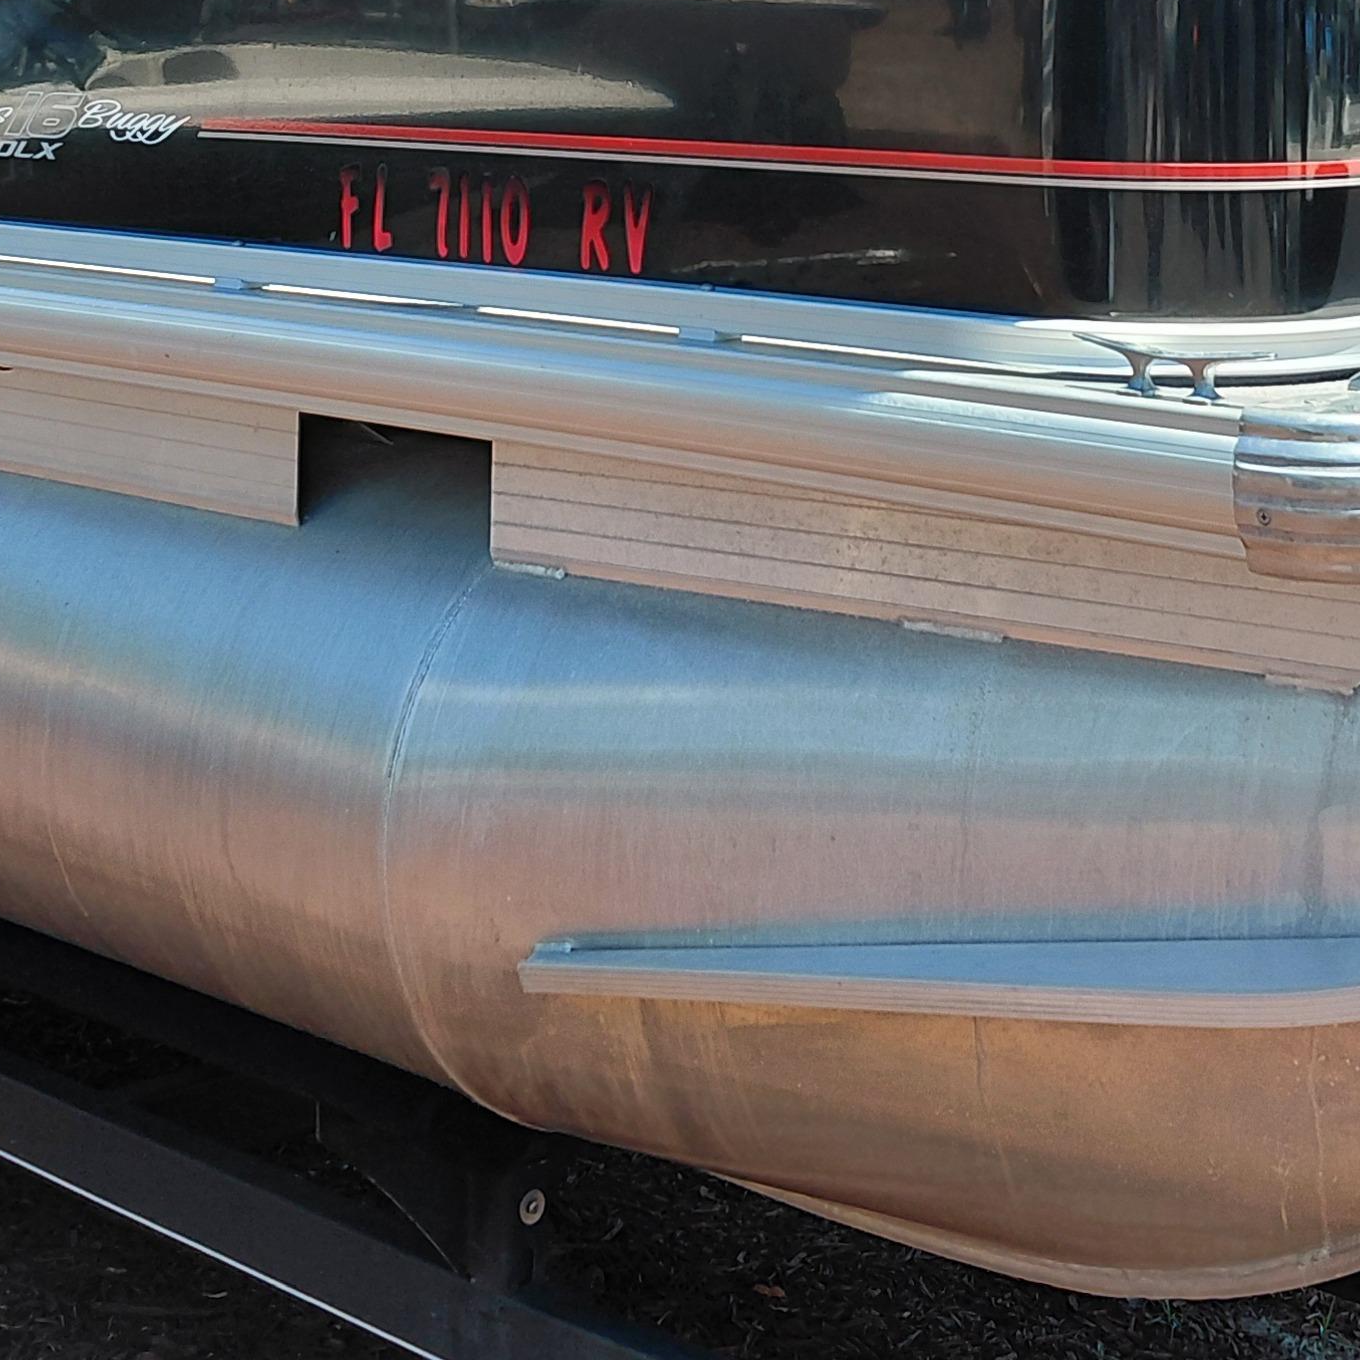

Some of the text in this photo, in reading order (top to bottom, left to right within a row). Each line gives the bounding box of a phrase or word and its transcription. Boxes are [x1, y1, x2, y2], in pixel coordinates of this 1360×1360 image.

[4, 91, 88, 139] 16
[77, 99, 191, 144] Buggy
[340, 162, 393, 252] FL
[580, 177, 654, 274] RV
